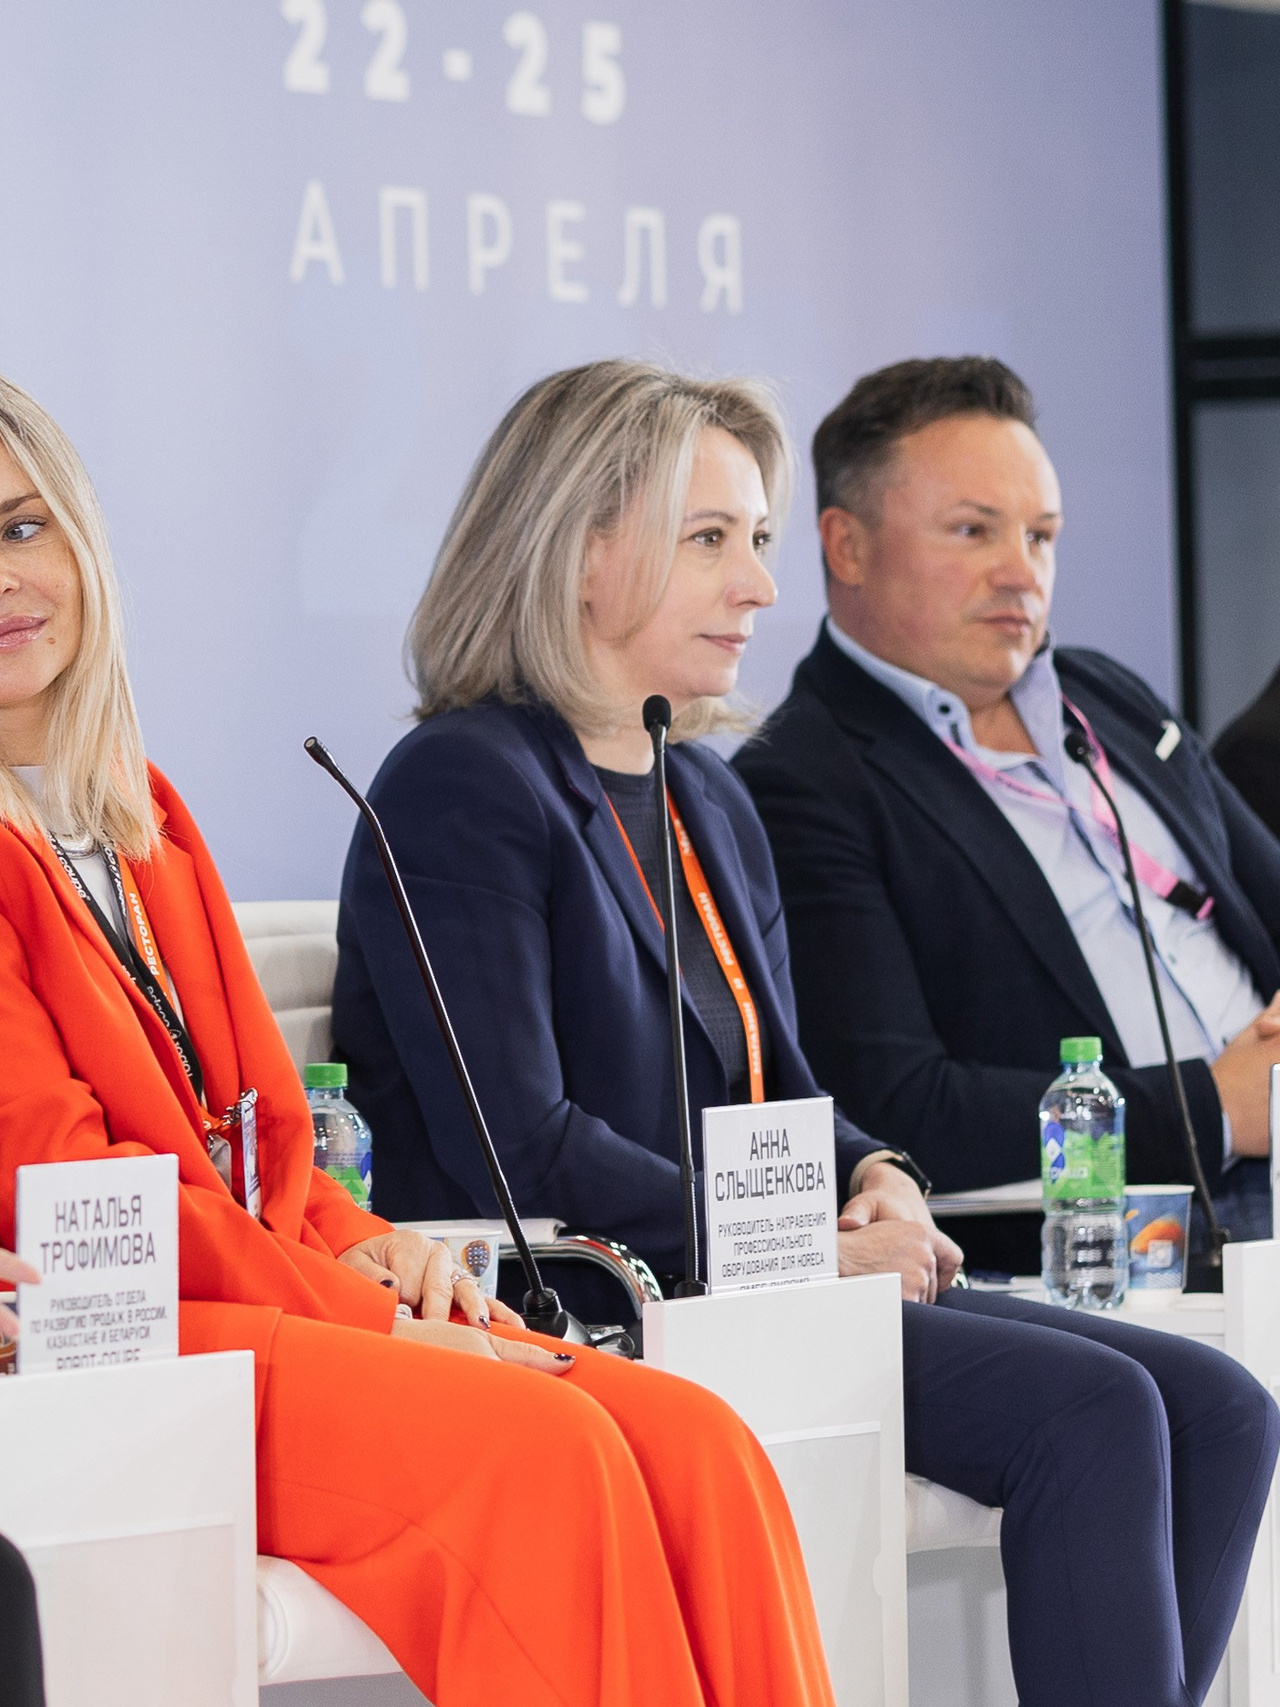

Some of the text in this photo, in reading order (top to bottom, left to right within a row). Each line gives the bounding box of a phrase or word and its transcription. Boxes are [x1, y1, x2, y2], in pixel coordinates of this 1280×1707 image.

[288, 180, 744, 313] АПРЕЛЯ
[129, 892, 160, 976] РЕСТОРАН
[749, 1128, 791, 1161] АННА
[715, 1161, 826, 1202] СЛЫЩЕНКОВА
[55, 1195, 143, 1234] НАТАЛЬЯ
[718, 1212, 827, 1238] РУКОВОДИТЕЛЬ НАПРАВЛЕНИЯ
[40, 1232, 157, 1275] ТРОФИМОВА
[733, 1233, 812, 1256] ПРОФЕССИОНАЛЬНОГО
[722, 1257, 779, 1278] ОБОРУДОВАНИЯ
[781, 1255, 796, 1271] ДЛЯ
